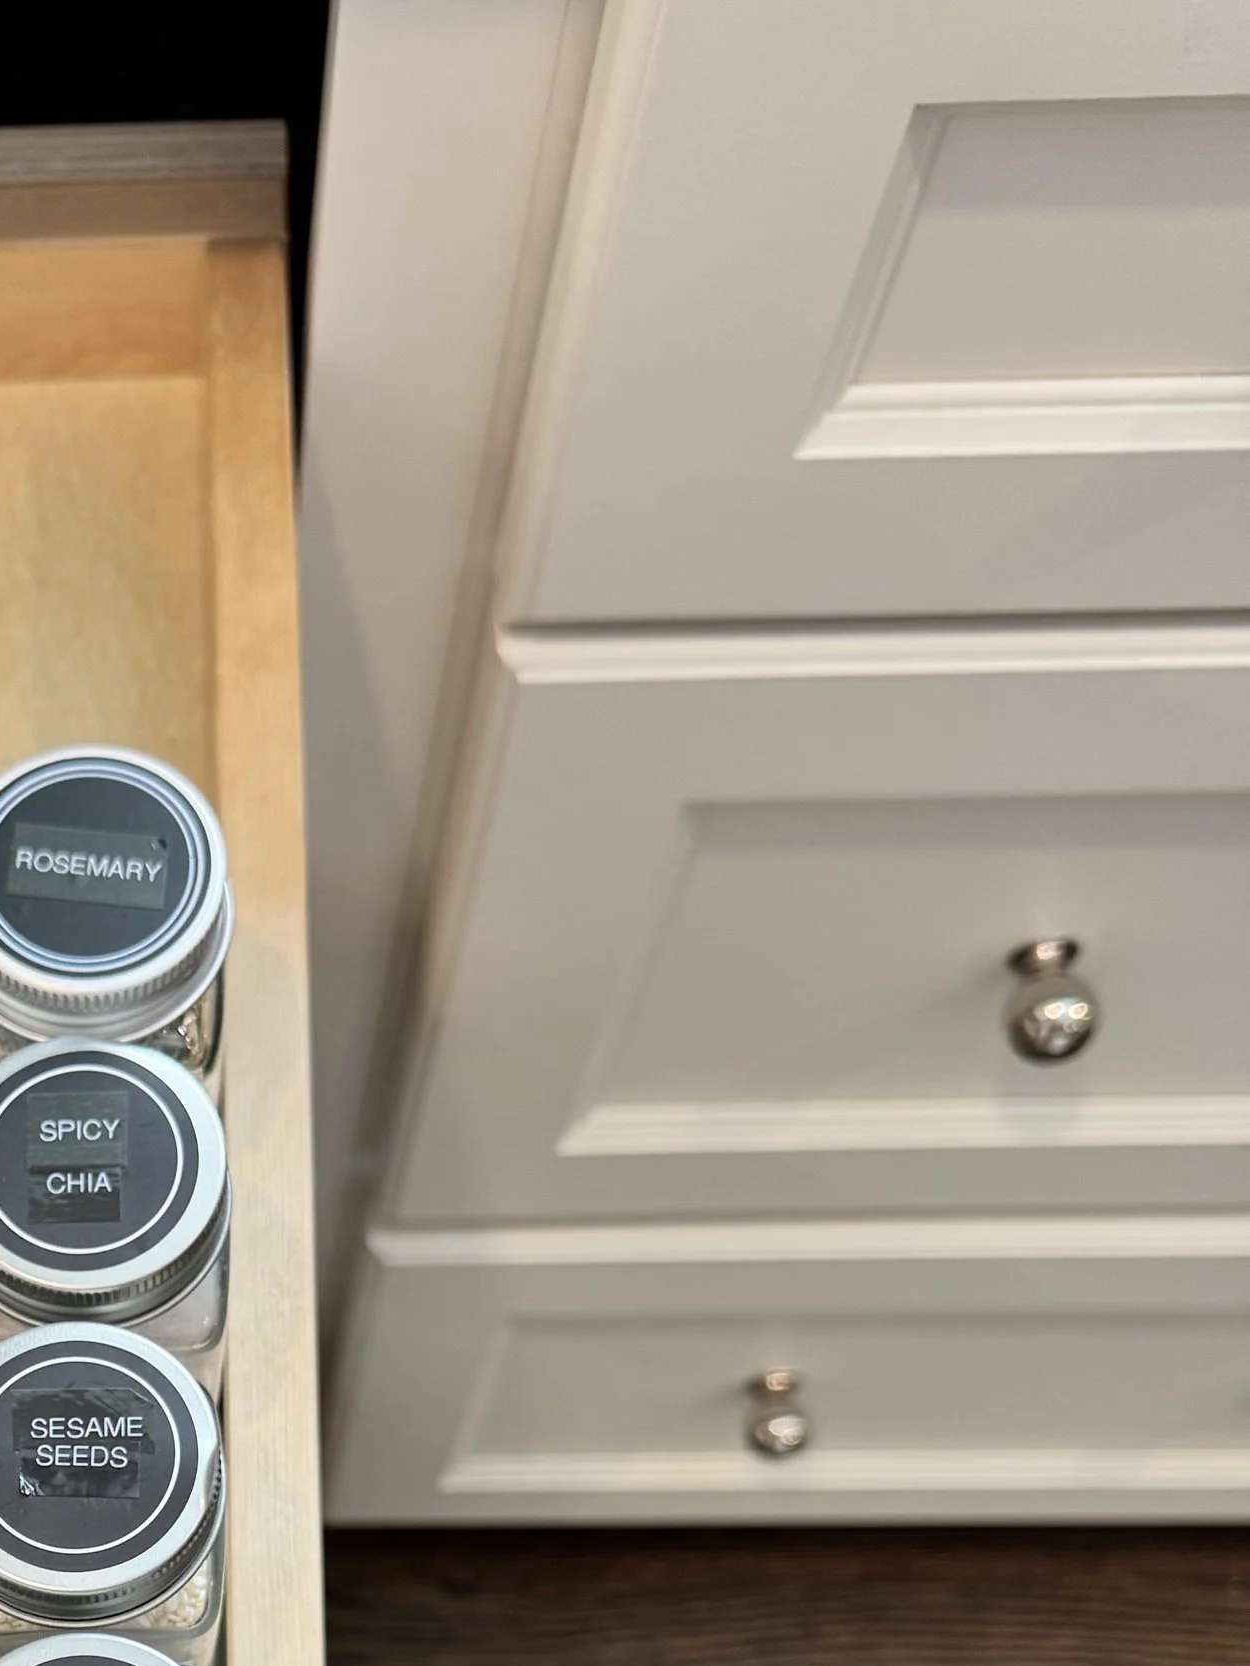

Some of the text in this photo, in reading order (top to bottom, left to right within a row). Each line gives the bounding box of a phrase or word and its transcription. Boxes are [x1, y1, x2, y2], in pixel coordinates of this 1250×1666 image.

[15, 846, 165, 884] ROSEMARY
[38, 1118, 121, 1142] SPICY
[45, 1170, 113, 1196] CHIA
[29, 1416, 145, 1442] SESAME
[34, 1443, 130, 1470] SEEDS
